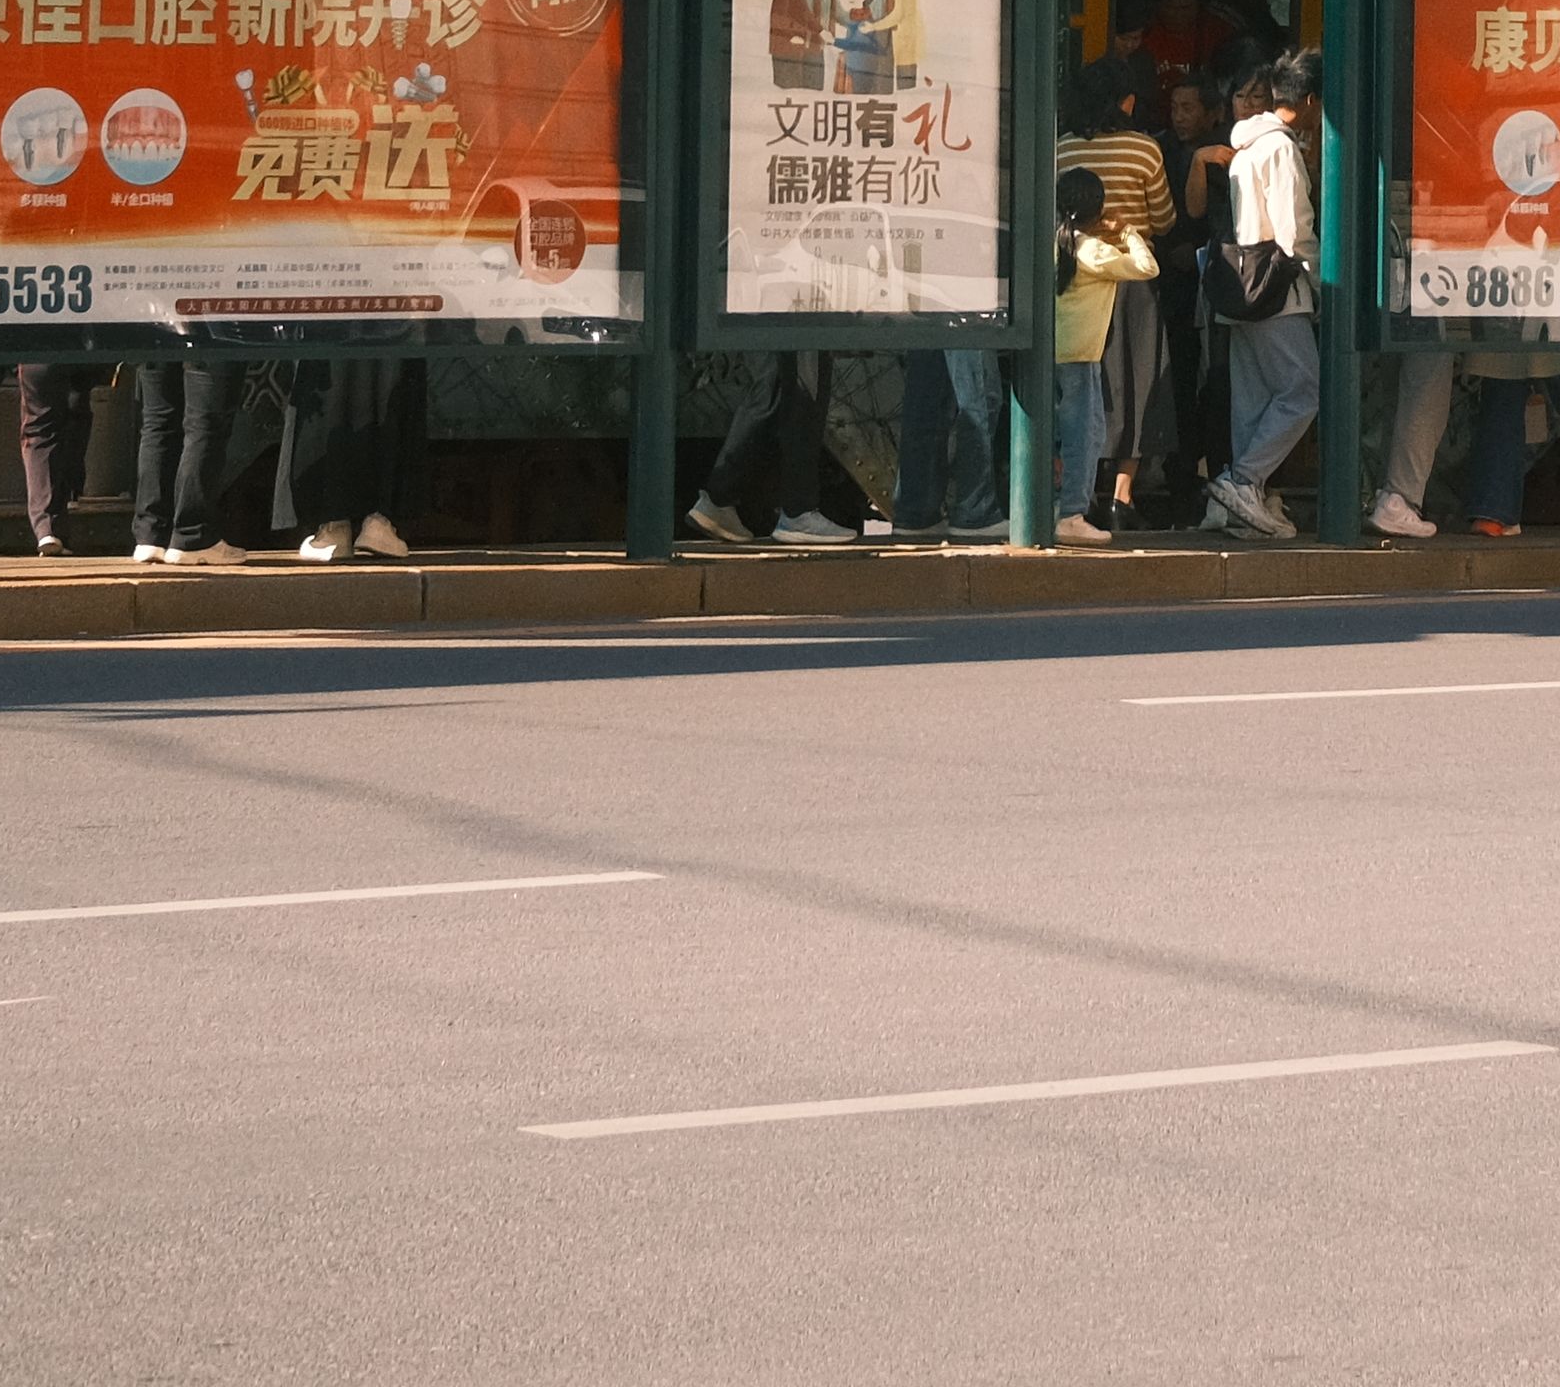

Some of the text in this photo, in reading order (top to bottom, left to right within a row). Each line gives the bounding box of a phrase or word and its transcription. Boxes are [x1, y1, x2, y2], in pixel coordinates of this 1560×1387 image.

[766, 75, 972, 156] 文明有礼
[231, 104, 460, 201] 免费送
[766, 154, 941, 205] 儒雅有你
[1466, 265, 1554, 308] 8886
